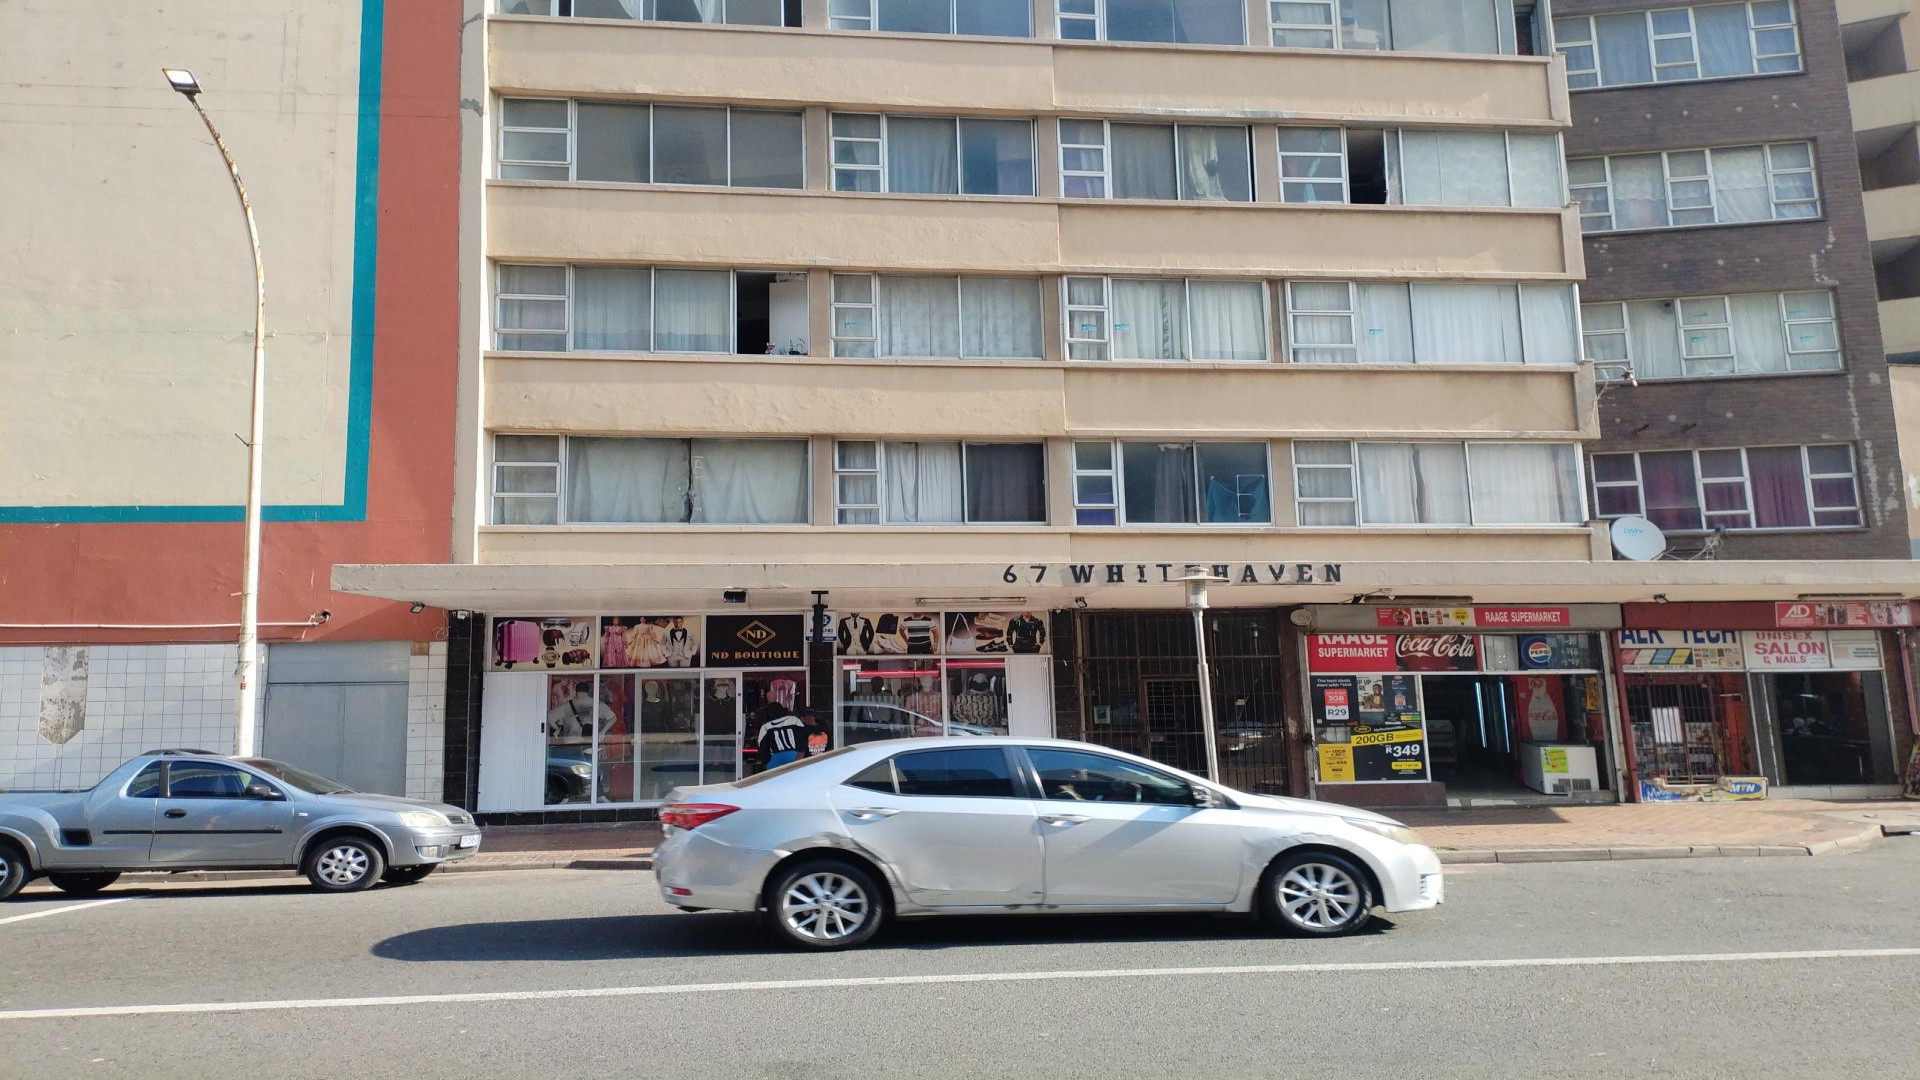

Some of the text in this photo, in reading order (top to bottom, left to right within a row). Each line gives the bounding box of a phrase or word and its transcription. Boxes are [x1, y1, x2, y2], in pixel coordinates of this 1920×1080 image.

[1070, 563, 1342, 583] WHITHAVEN
[1485, 611, 1561, 623] RAAGE SUPERMARKET
[746, 629, 767, 639] ND
[1756, 631, 1813, 640] UNISEX
[1396, 634, 1475, 658] Coca-Cola
[1754, 642, 1826, 655] SALON
[711, 650, 800, 660] ND BOUTIQUE
[1318, 648, 1389, 658] SUPERMARKET
[1776, 656, 1807, 664] NAILS
[1327, 708, 1347, 716] R29
[1356, 733, 1394, 745] 200GB
[1385, 744, 1420, 757] R349
[1729, 783, 1755, 793] MTN
